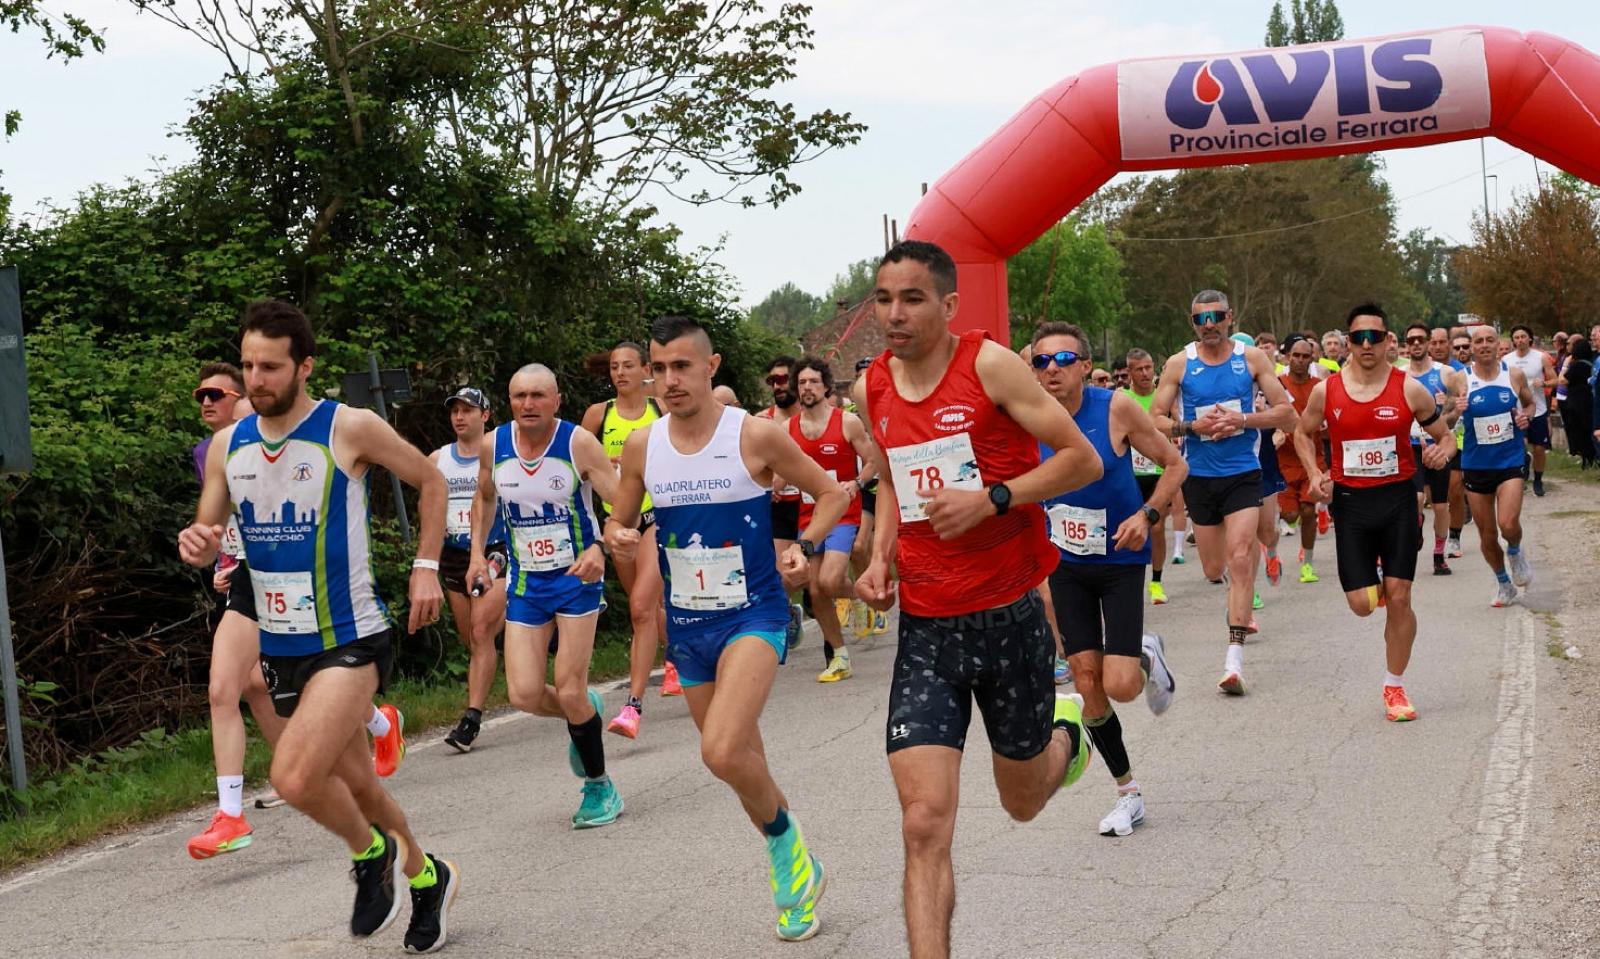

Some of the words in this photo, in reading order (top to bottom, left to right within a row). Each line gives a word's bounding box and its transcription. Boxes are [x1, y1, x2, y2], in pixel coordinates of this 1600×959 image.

[1165, 38, 1443, 130] AVIS
[1170, 124, 1326, 153] Provinciale
[1337, 114, 1438, 140] Ferrara
[1358, 450, 1383, 466] 198
[654, 478, 732, 495] QUADRILATERO
[910, 466, 944, 491] 78
[671, 493, 712, 505] FERRARA
[246, 534, 305, 542] COMACCHIO
[282, 525, 312, 533] CLUB
[1061, 519, 1087, 540] 185
[527, 538, 555, 557] 135
[695, 569, 705, 591] 1
[265, 591, 287, 614] 75
